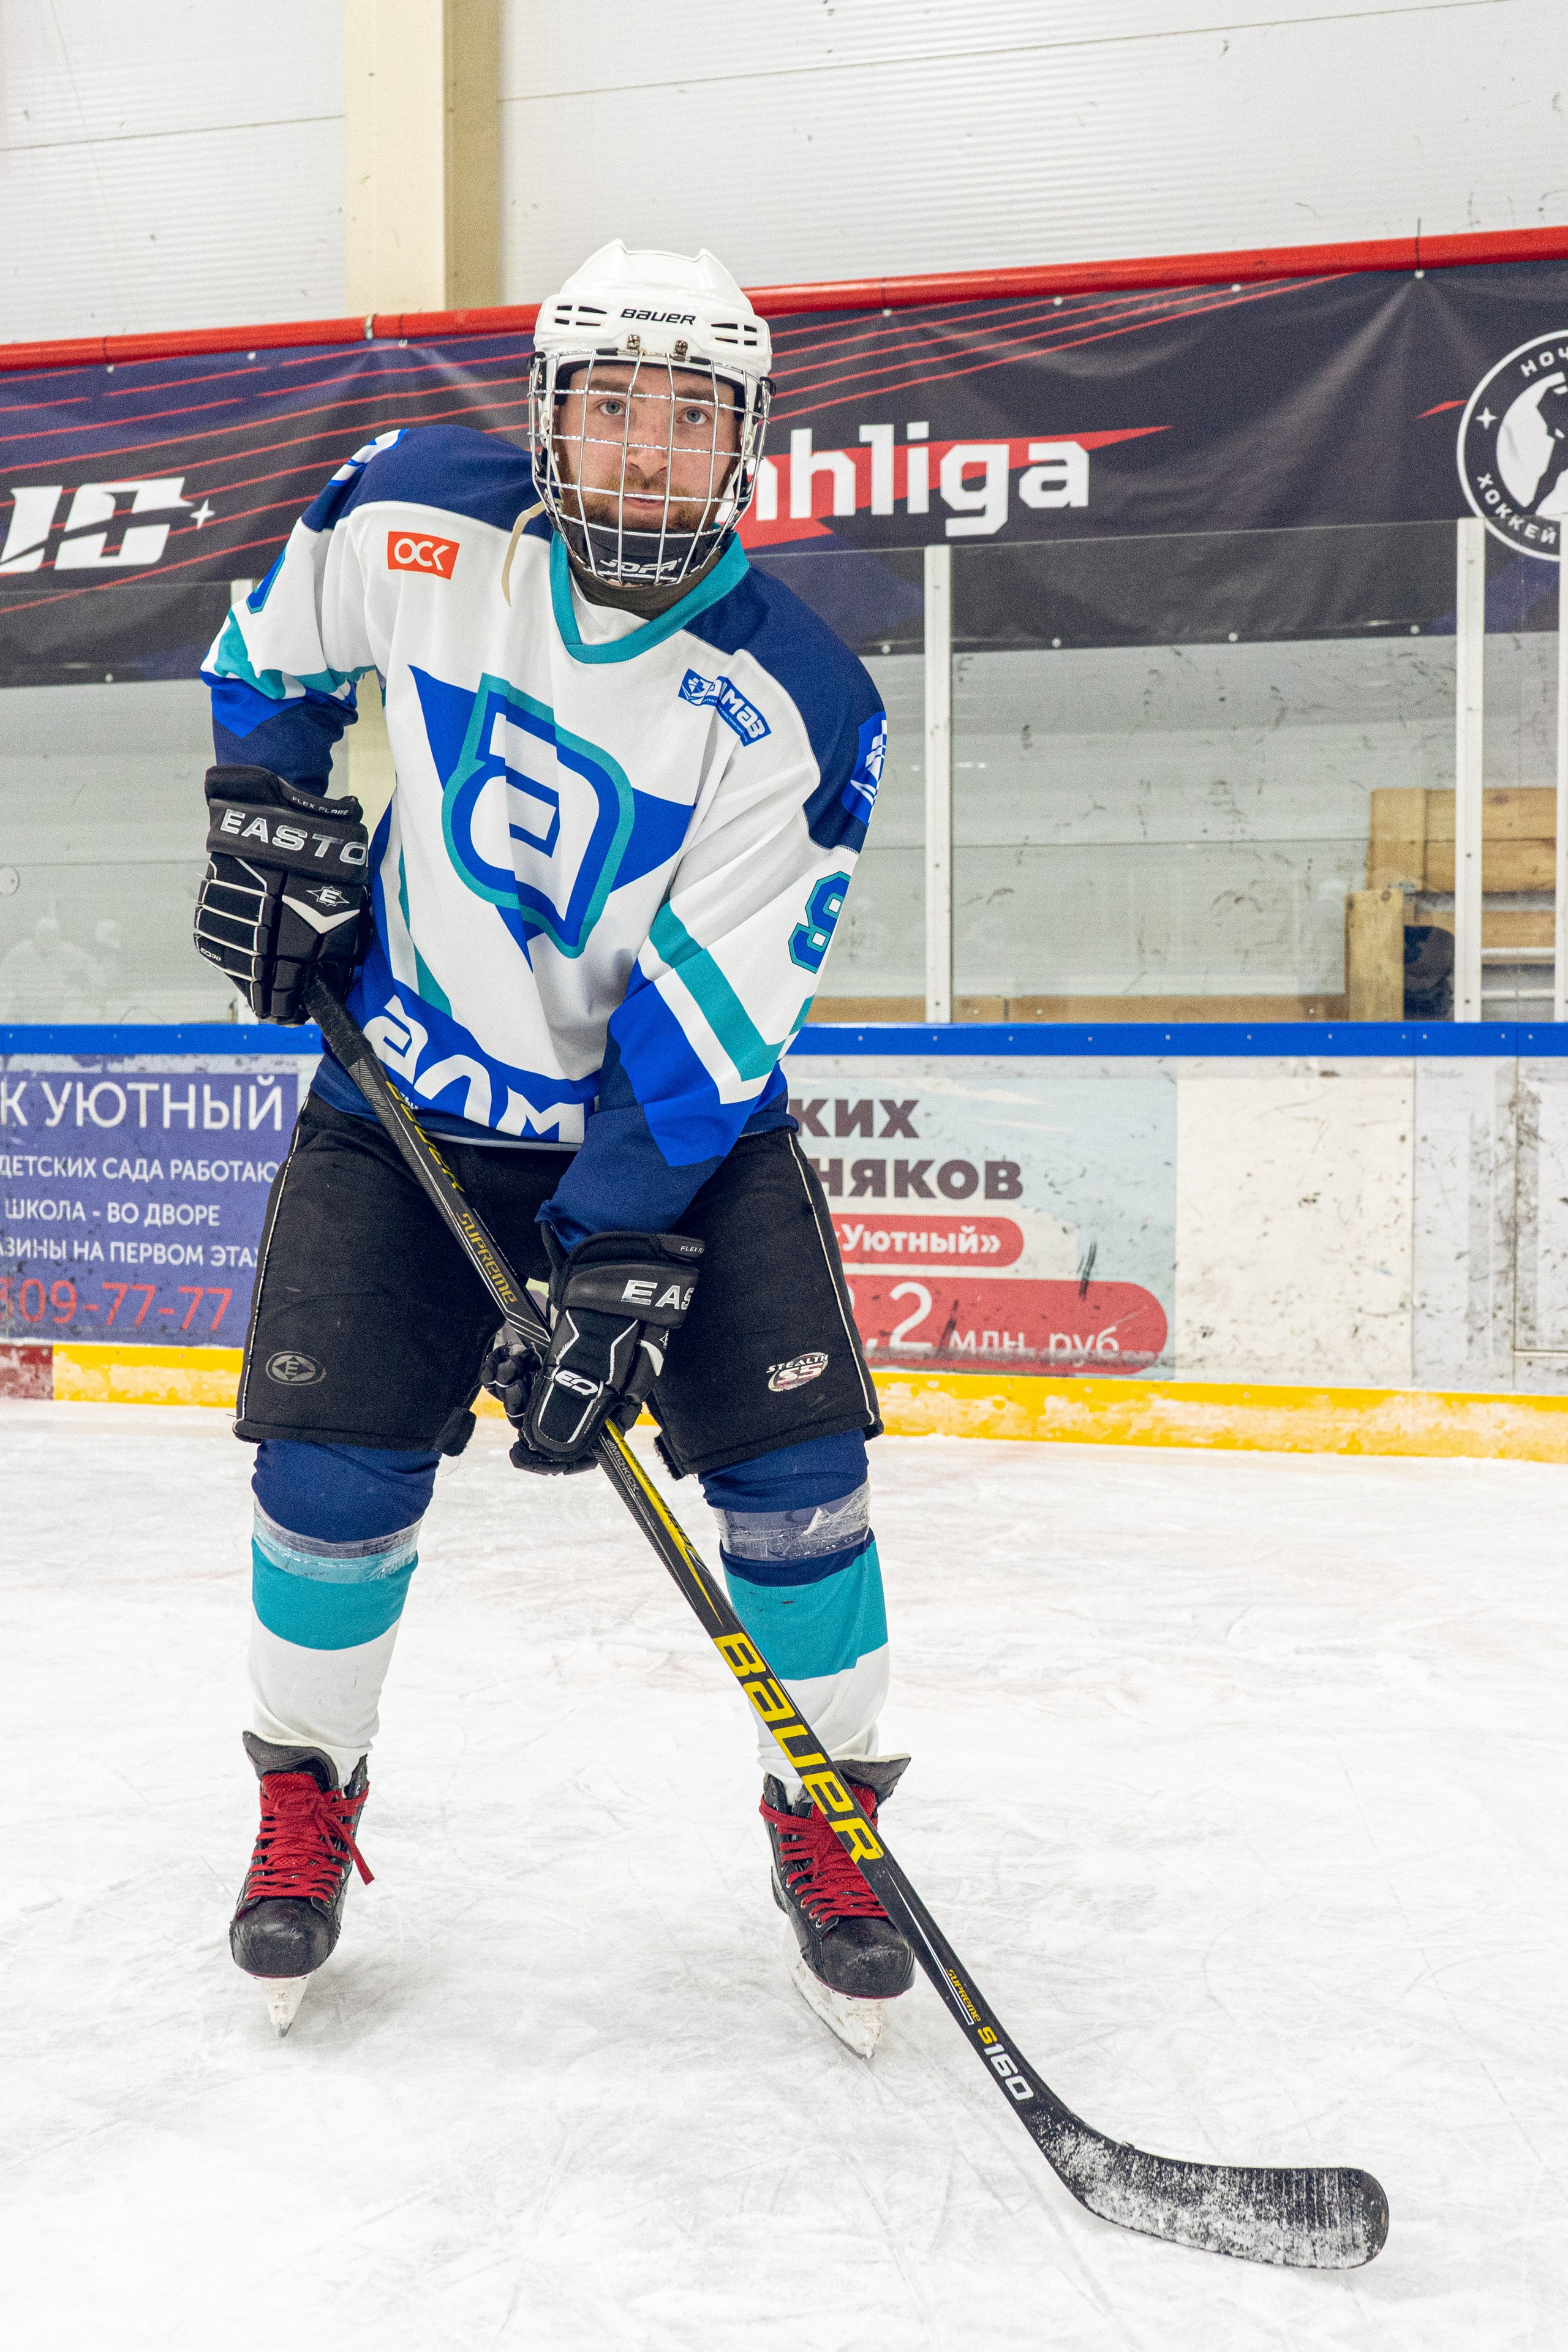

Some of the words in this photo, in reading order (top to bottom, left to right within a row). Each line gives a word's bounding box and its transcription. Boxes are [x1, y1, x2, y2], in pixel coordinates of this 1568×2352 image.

[1477, 473, 1556, 545] ХОККЕЙ
[292, 796, 315, 809] FLEX
[318, 807, 349, 815] FLARE
[220, 809, 369, 867] EASTO
[40, 1074, 282, 1131] УЮТНЫЙ
[789, 1099, 919, 1138] КИХ
[102, 1157, 164, 1183] САДА
[170, 1159, 280, 1183] РАБОТАЮ
[6, 1199, 86, 1221] ШКОЛА
[107, 1202, 138, 1224] ВО
[144, 1203, 221, 1227] ДВОРЕ
[74, 1240, 104, 1262] НА
[110, 1242, 204, 1266] ПЕРВОМ
[211, 1246, 258, 1268] ЭТА
[848, 1281, 933, 1358] ,2
[766, 1354, 828, 1373] STEALTH
[978, 2026, 1034, 2101] S160
